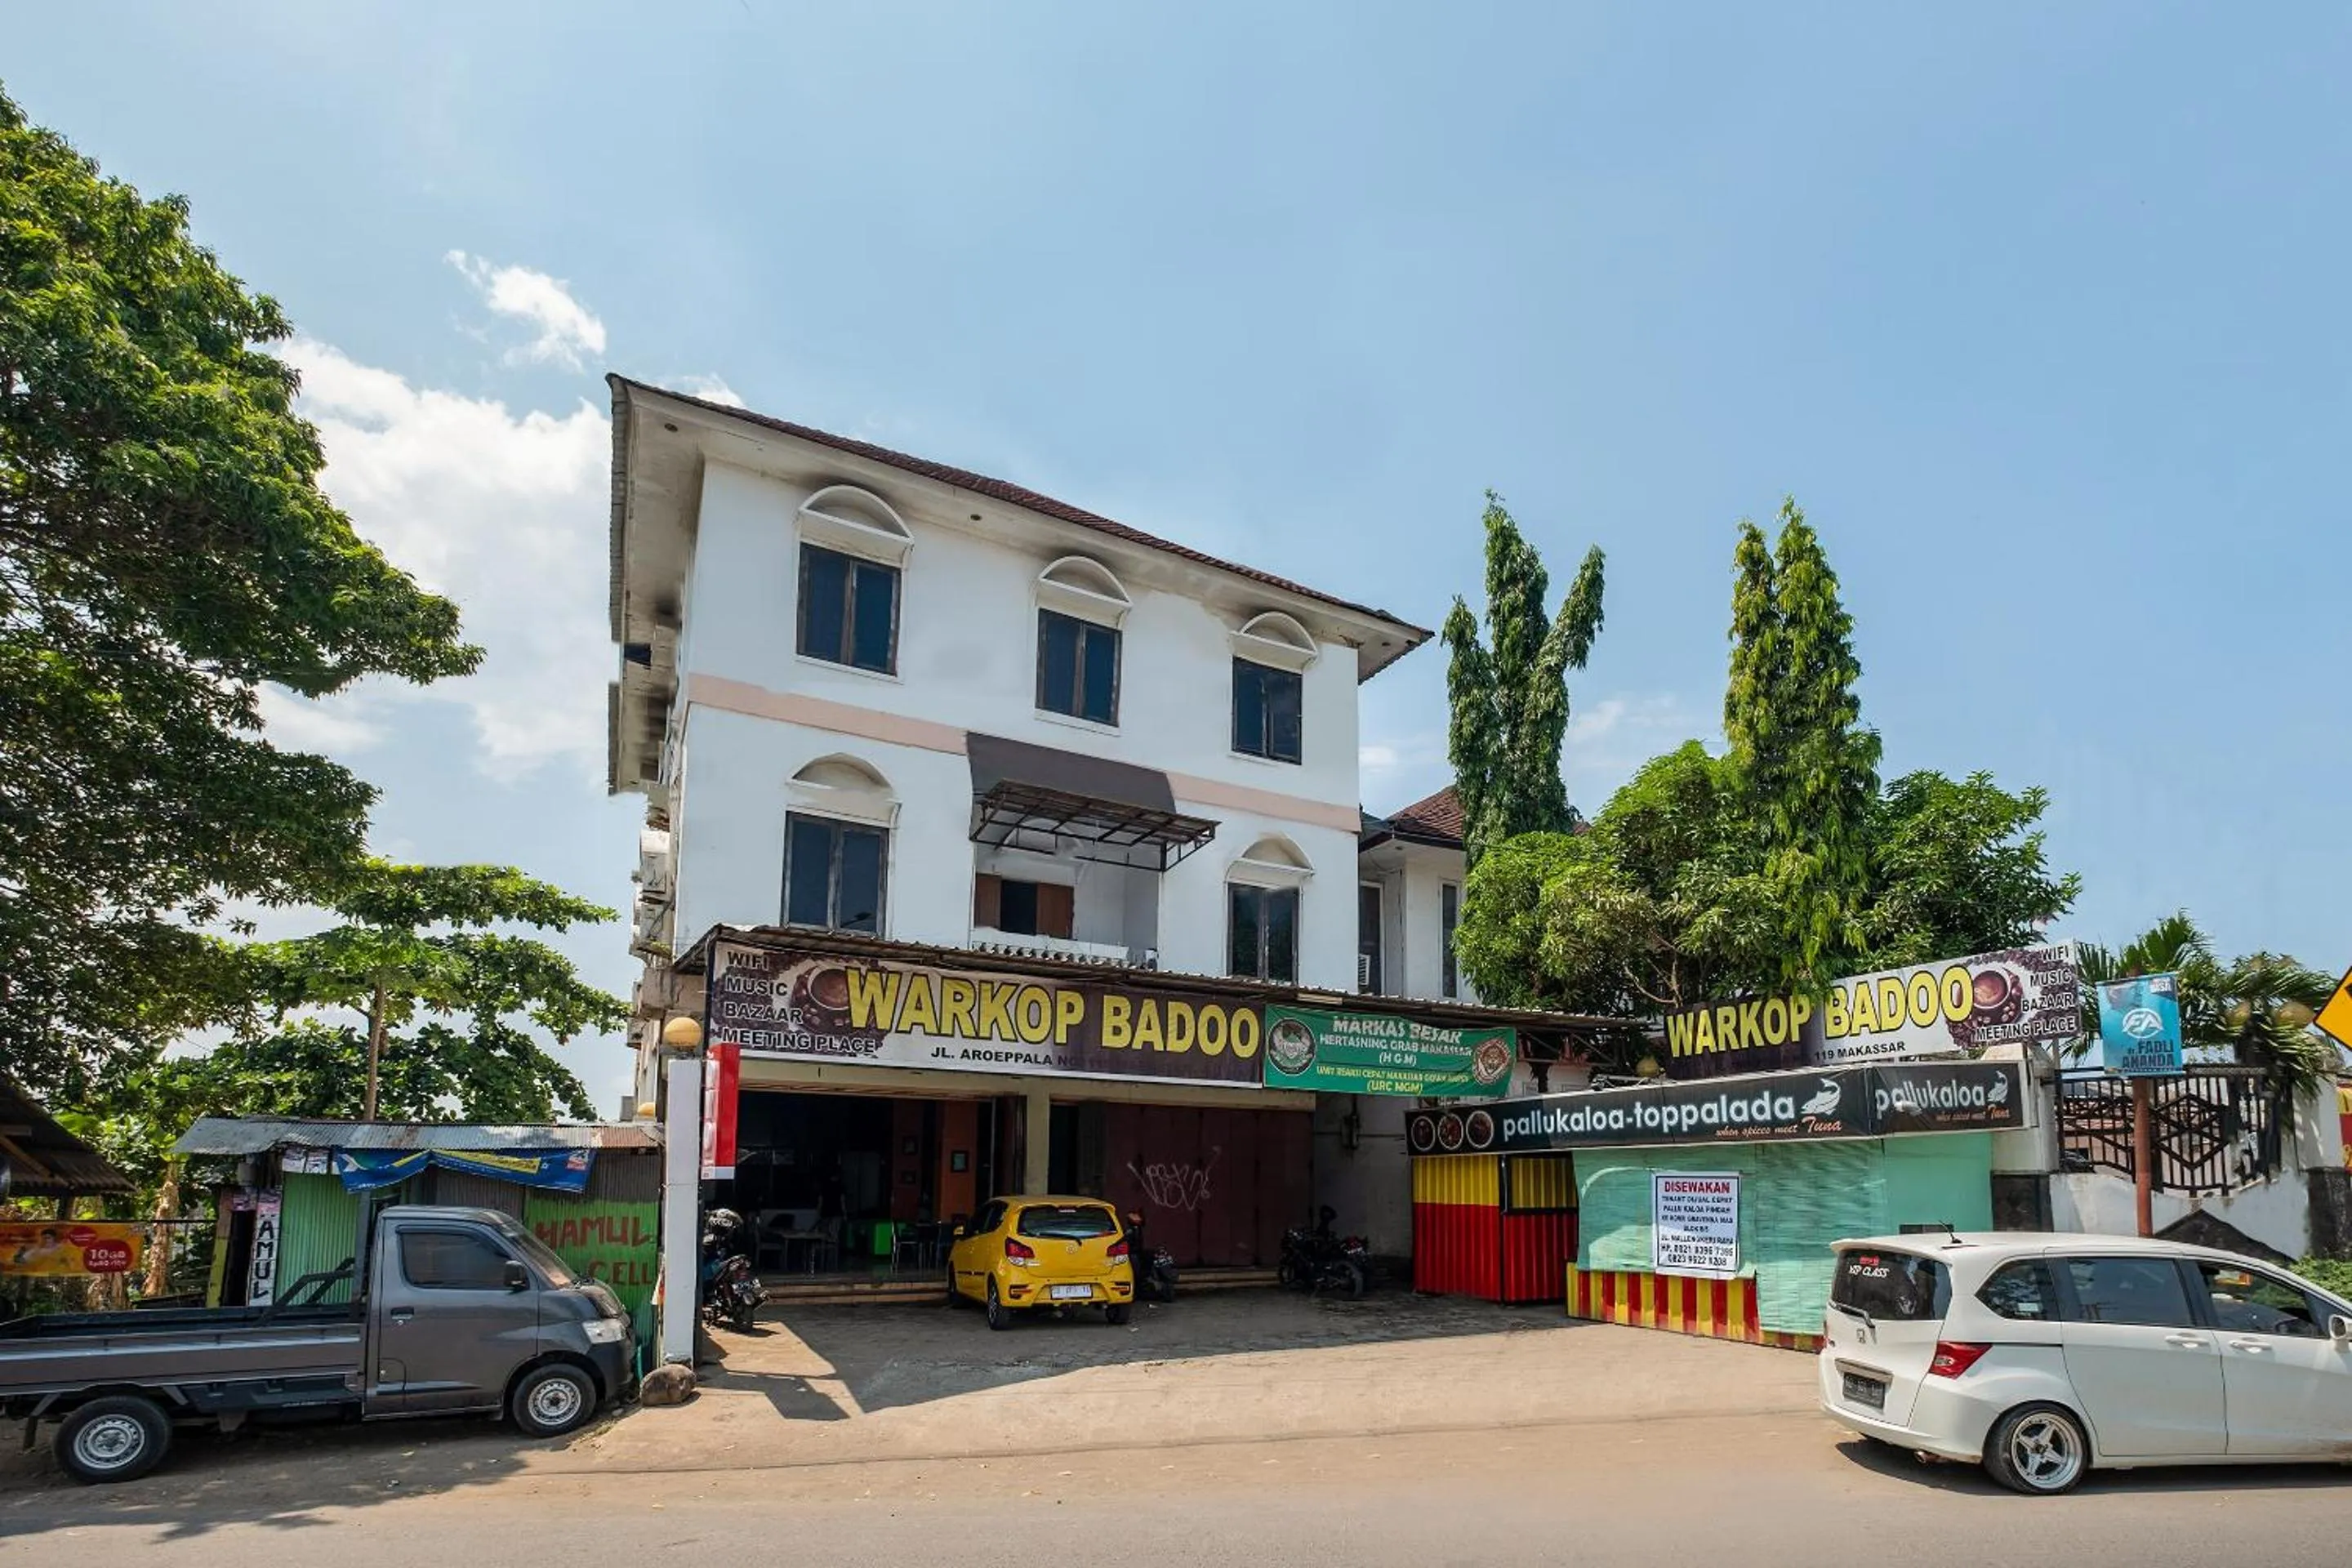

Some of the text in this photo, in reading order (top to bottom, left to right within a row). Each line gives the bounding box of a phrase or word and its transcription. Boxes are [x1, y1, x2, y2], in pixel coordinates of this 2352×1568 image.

[727, 951, 769, 970] WIFI
[2042, 946, 2069, 960] WIFI
[725, 977, 788, 996] MUSIC
[2030, 969, 2072, 987] MUSIC
[725, 1002, 803, 1023] BAZAAR
[845, 965, 1261, 1058] WARKOP BADOO
[1667, 964, 1974, 1058] WARKOP BADOO
[2021, 993, 2074, 1012] BAZAAR
[1333, 1019, 1463, 1044] MARKAS BESAR
[1976, 1017, 2076, 1041] MEETING PLACE
[723, 1027, 876, 1054] MEETING PLACE
[1320, 1033, 1388, 1049] HERTASNING
[1390, 1040, 1419, 1053] GRAB
[1815, 1041, 1906, 1060] 119 MAKASSAR
[2138, 1040, 2174, 1054] FADLI
[931, 1047, 954, 1059] JL.
[960, 1049, 1053, 1065] AROEPPALA
[1875, 1079, 1986, 1120] pallukaloa
[1717, 1125, 1739, 1137] when
[1802, 1116, 1842, 1134] Tuna
[1664, 1180, 1731, 1194] DISEWAKAN
[253, 1214, 275, 1298] AMUL
